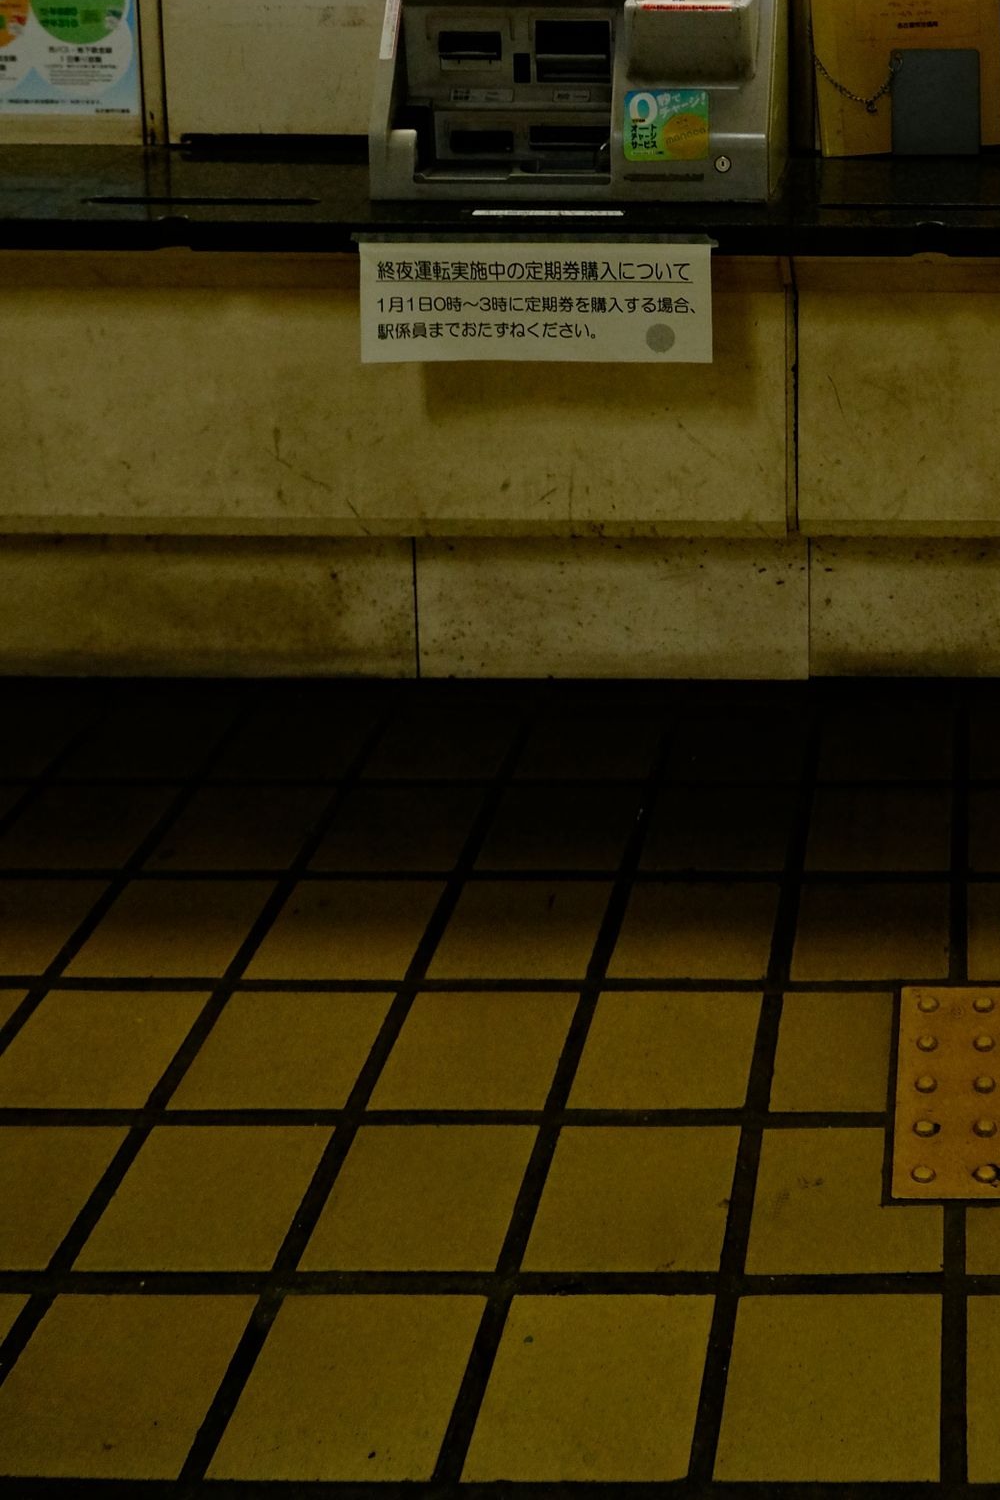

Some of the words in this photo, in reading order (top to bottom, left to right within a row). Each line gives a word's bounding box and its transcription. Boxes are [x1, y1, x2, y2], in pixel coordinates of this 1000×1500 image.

[631, 124, 657, 132] オート
[377, 261, 690, 281] 終夜運転実施中の定期券購入について
[378, 322, 596, 340] 駅係員までおたずねください。
